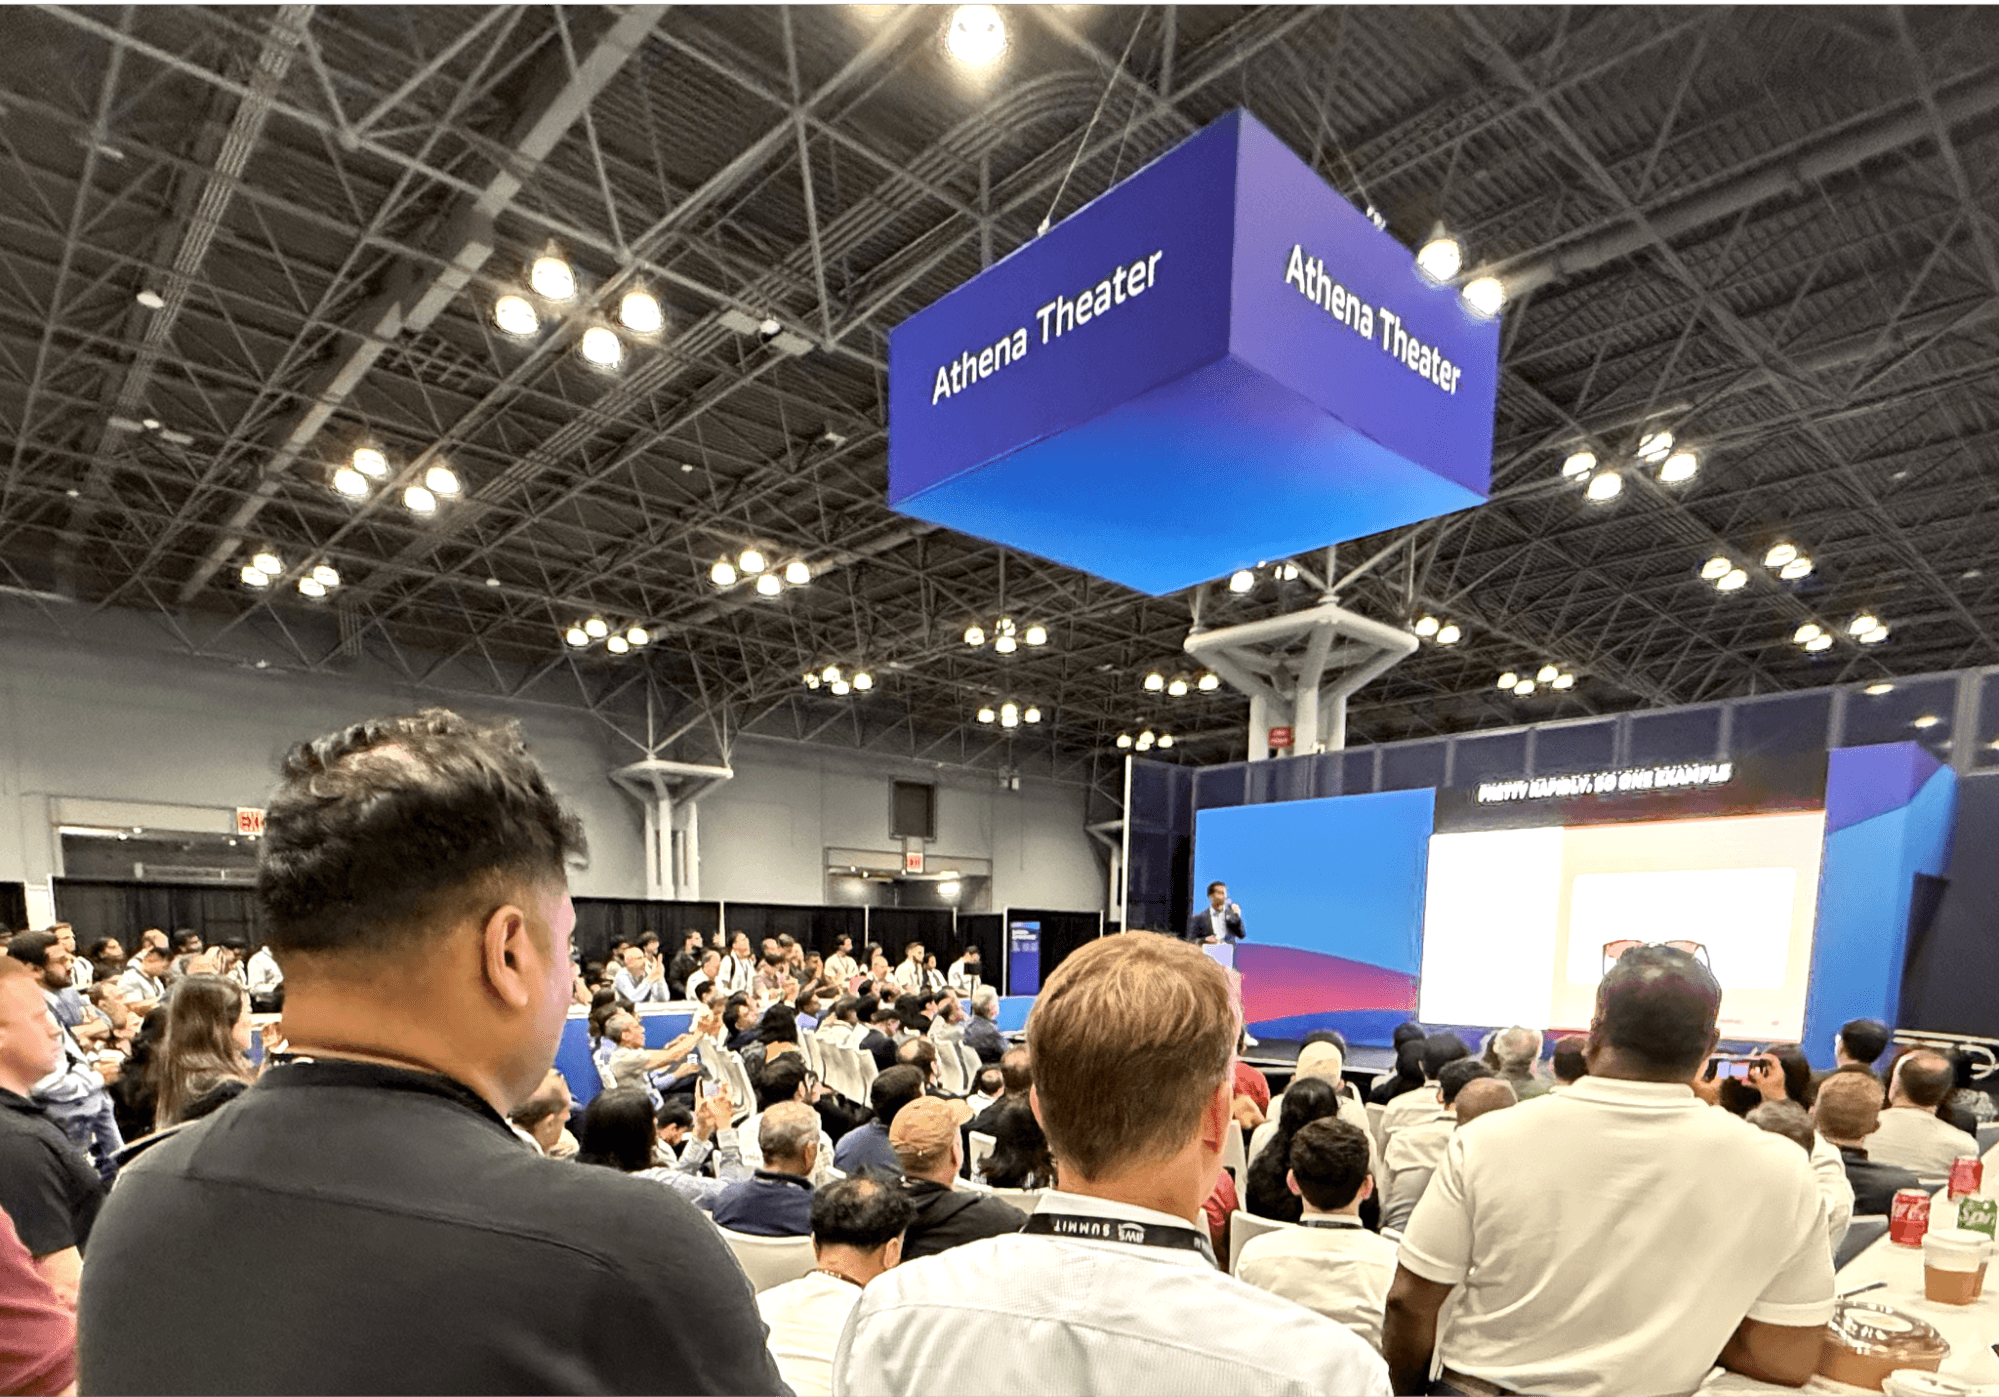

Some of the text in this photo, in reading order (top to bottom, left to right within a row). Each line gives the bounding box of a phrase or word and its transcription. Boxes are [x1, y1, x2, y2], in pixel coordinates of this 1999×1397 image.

[932, 250, 1163, 405] Athena Theater
[1285, 244, 1462, 395] Athena Theater
[1617, 768, 1653, 791] ONE
[1653, 763, 1733, 787] EXAMPLE
[1053, 1219, 1111, 1237] SUMMIT
